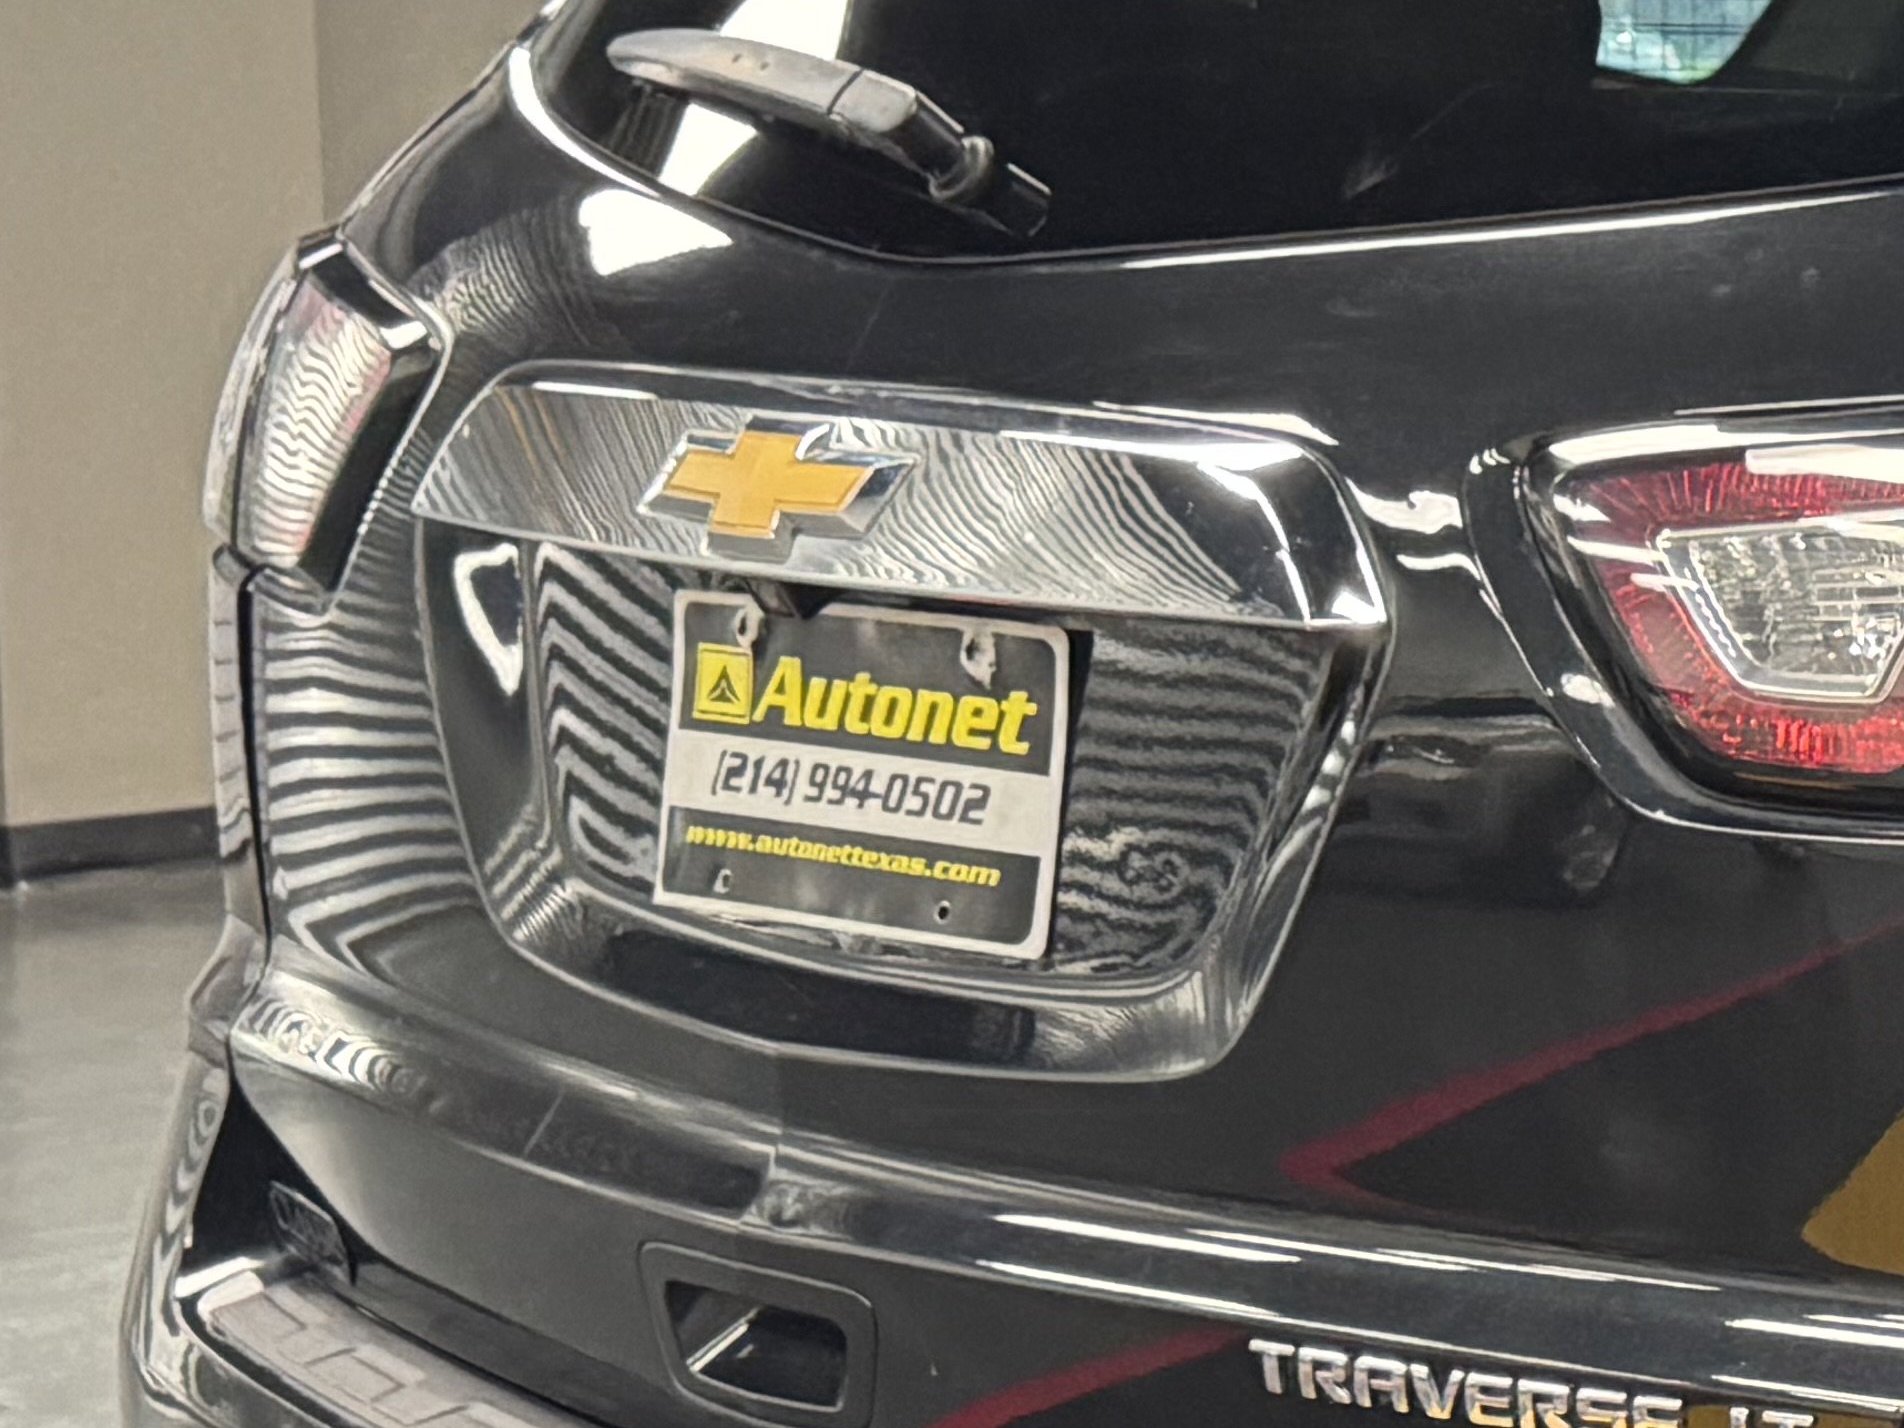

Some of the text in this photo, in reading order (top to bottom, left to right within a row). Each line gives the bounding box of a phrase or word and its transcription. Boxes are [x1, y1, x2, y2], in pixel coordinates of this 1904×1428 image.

[752, 656, 1038, 755] Autonet
[711, 750, 991, 826] (214) 994-0502
[686, 825, 1001, 887] www.autonettexas.com
